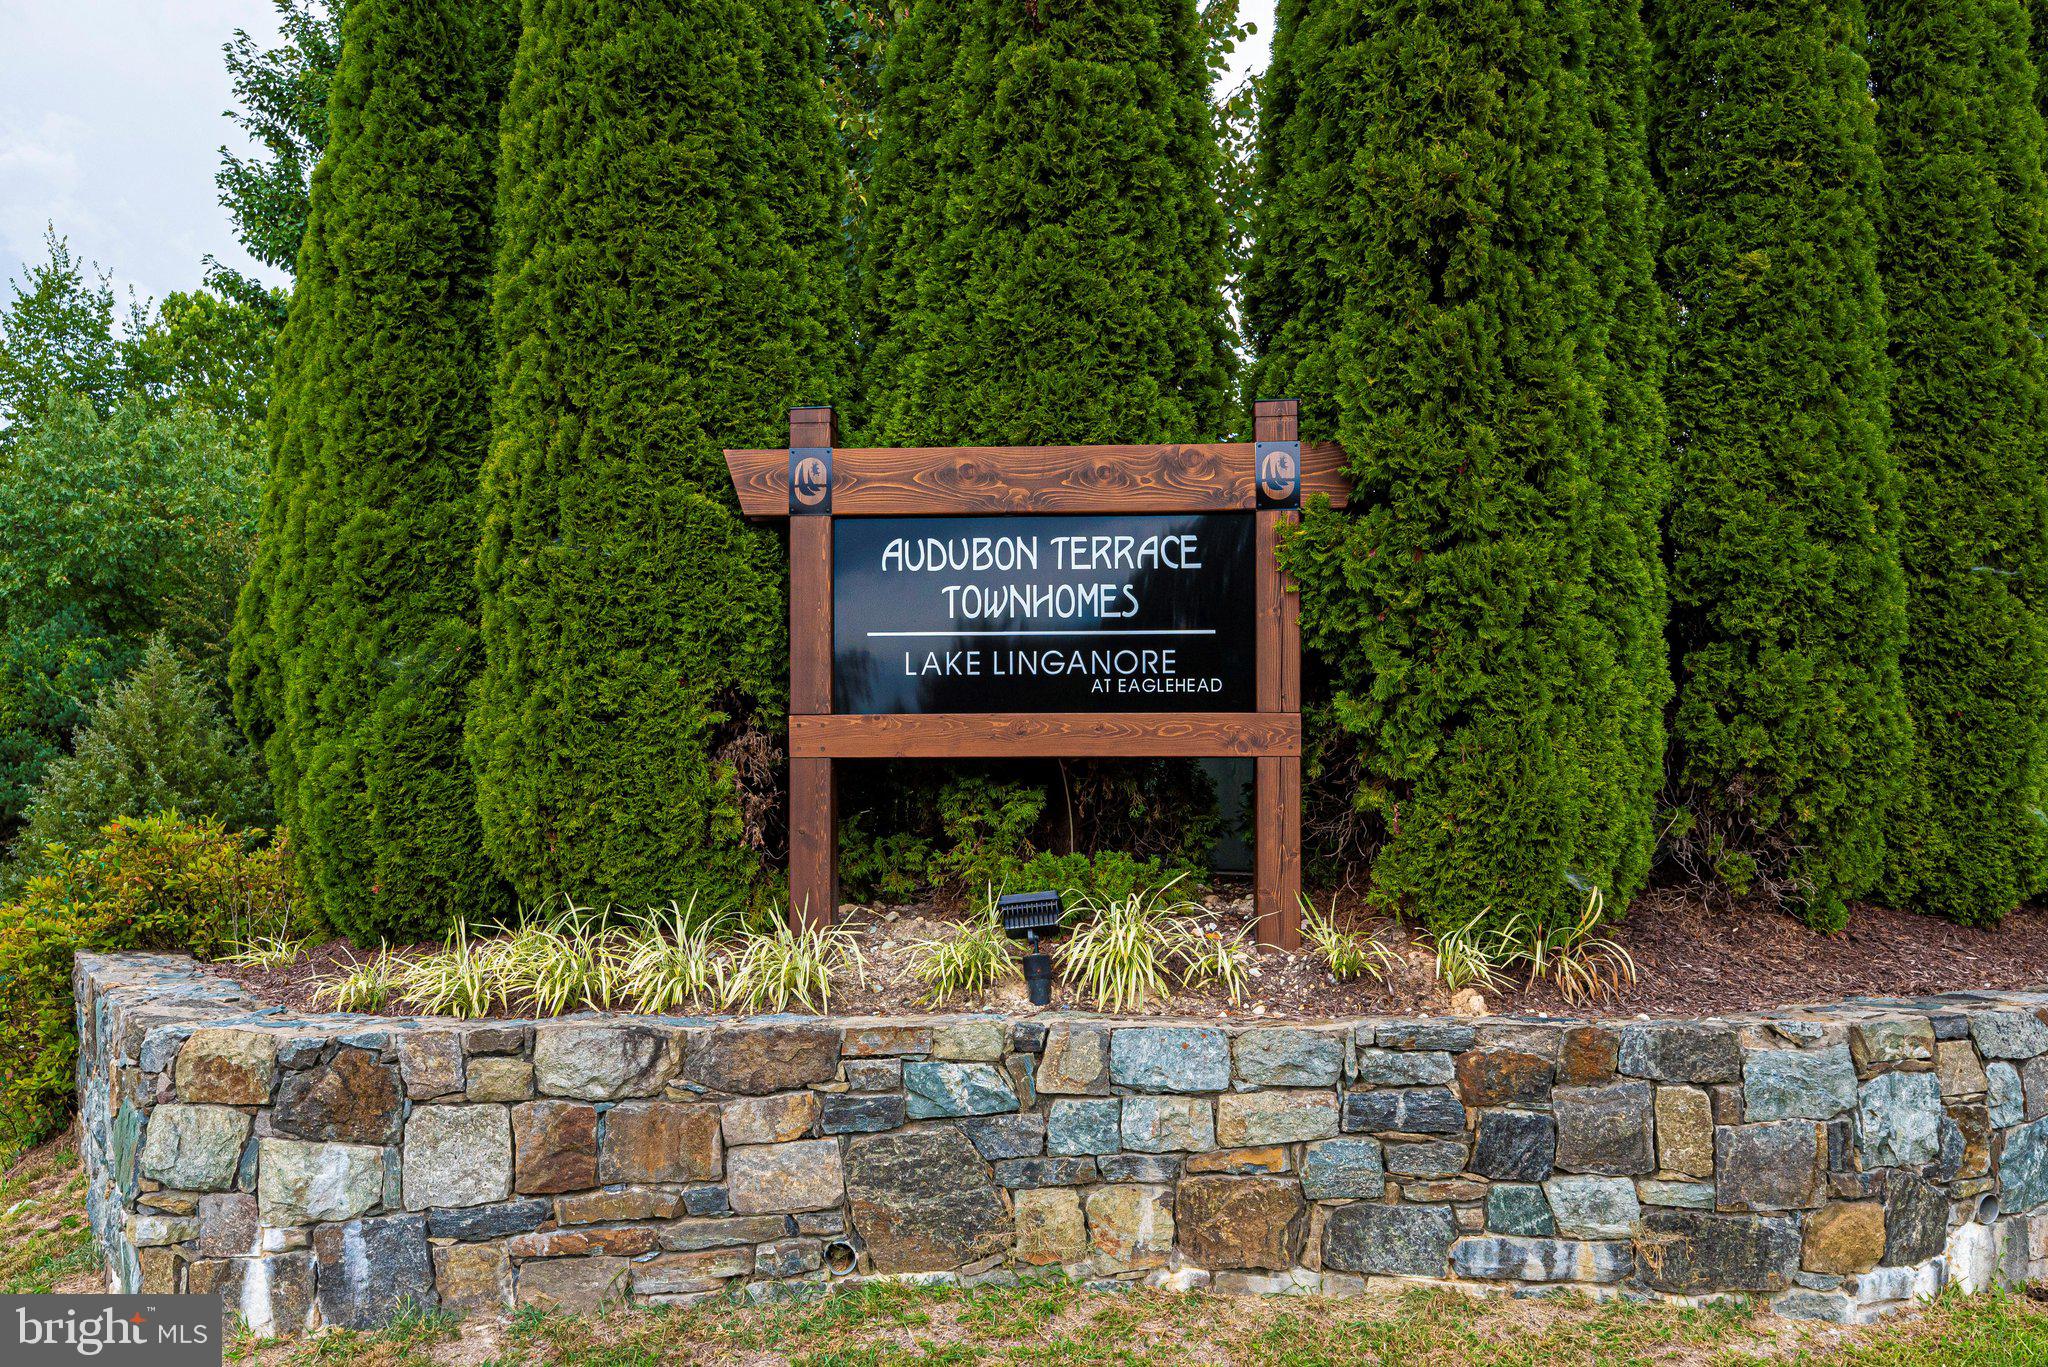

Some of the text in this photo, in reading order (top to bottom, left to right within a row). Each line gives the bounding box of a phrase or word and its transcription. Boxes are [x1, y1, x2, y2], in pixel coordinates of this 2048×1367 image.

[881, 535, 1202, 572] AUDUBON TERRACE
[941, 583, 1139, 619] TOWNHOMES
[905, 649, 1176, 676] LAKE LINGANORE
[1091, 678, 1223, 693] AT EAGLEHEAD
